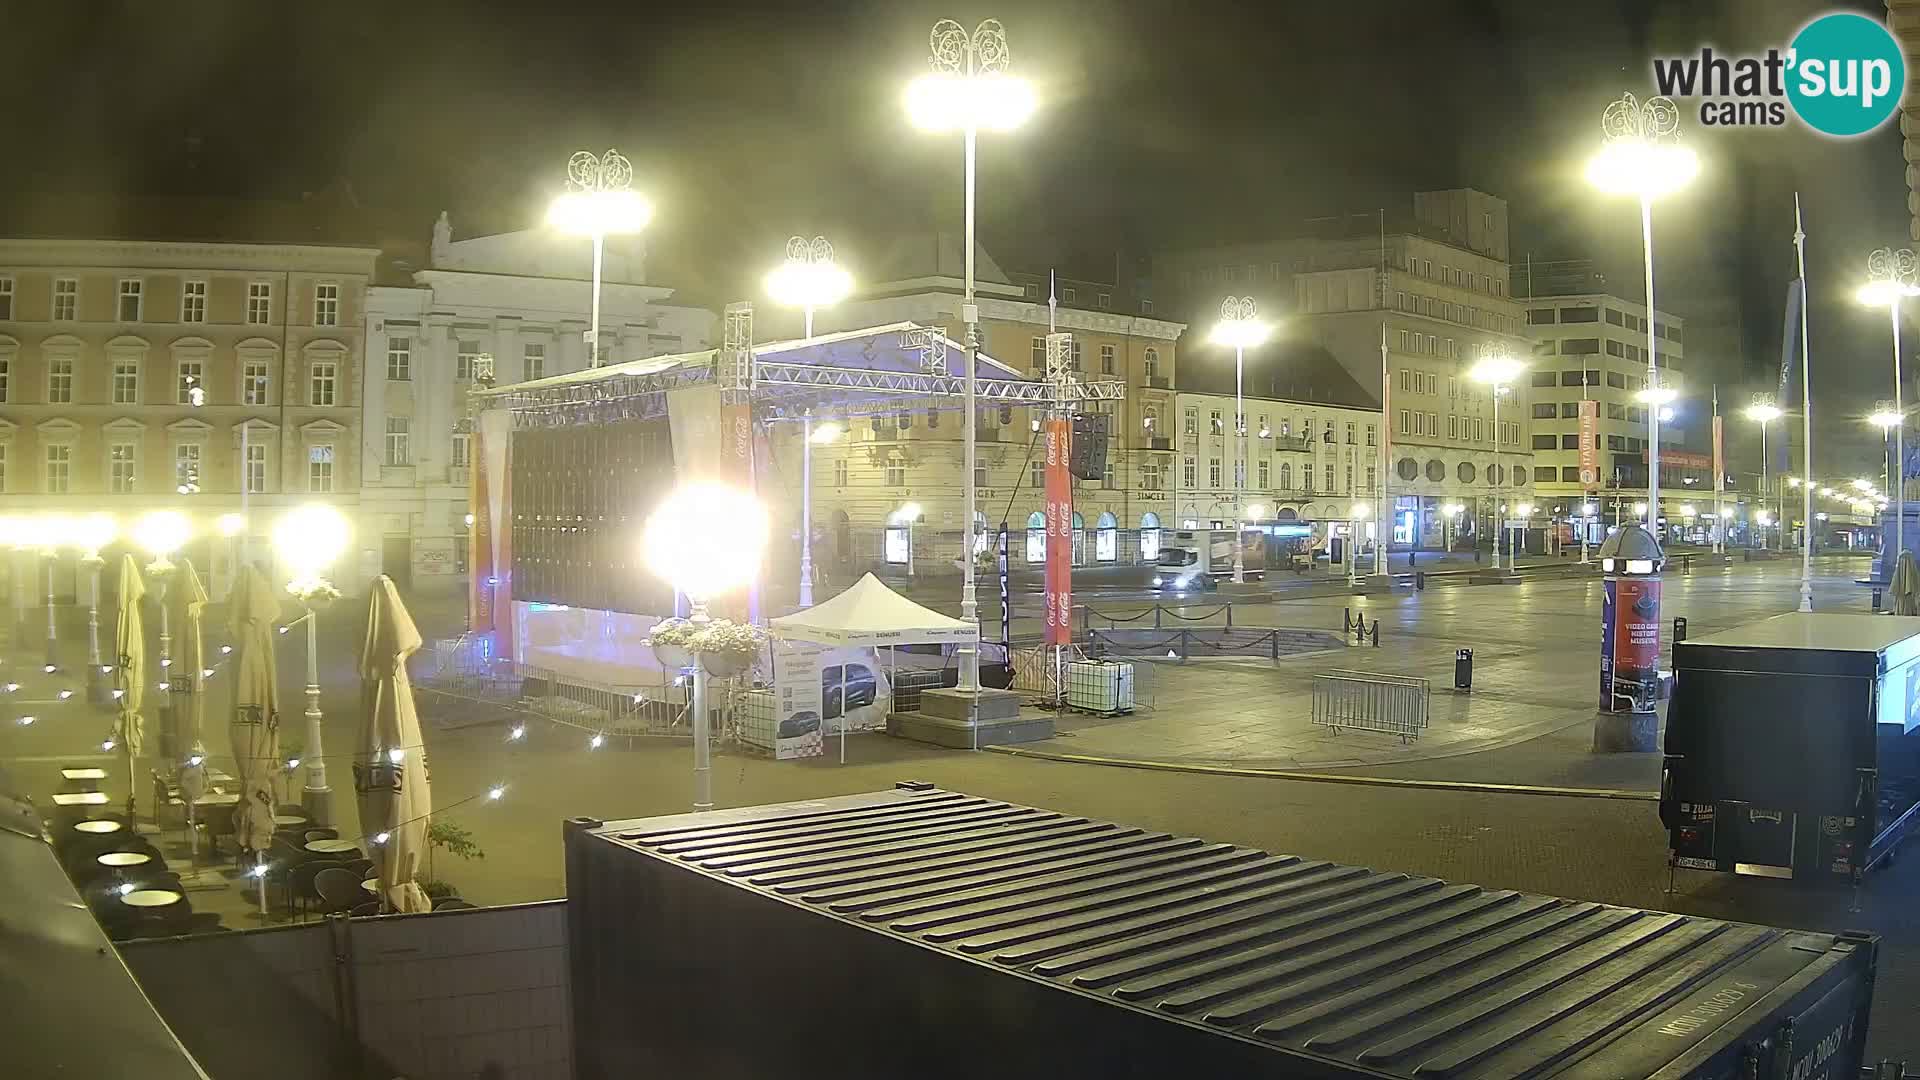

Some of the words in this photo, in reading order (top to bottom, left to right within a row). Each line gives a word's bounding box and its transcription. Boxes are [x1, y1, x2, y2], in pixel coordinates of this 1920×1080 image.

[961, 489, 996, 499] SGER
[1137, 492, 1166, 500] SINGER
[1690, 989, 1745, 1016] 300629
